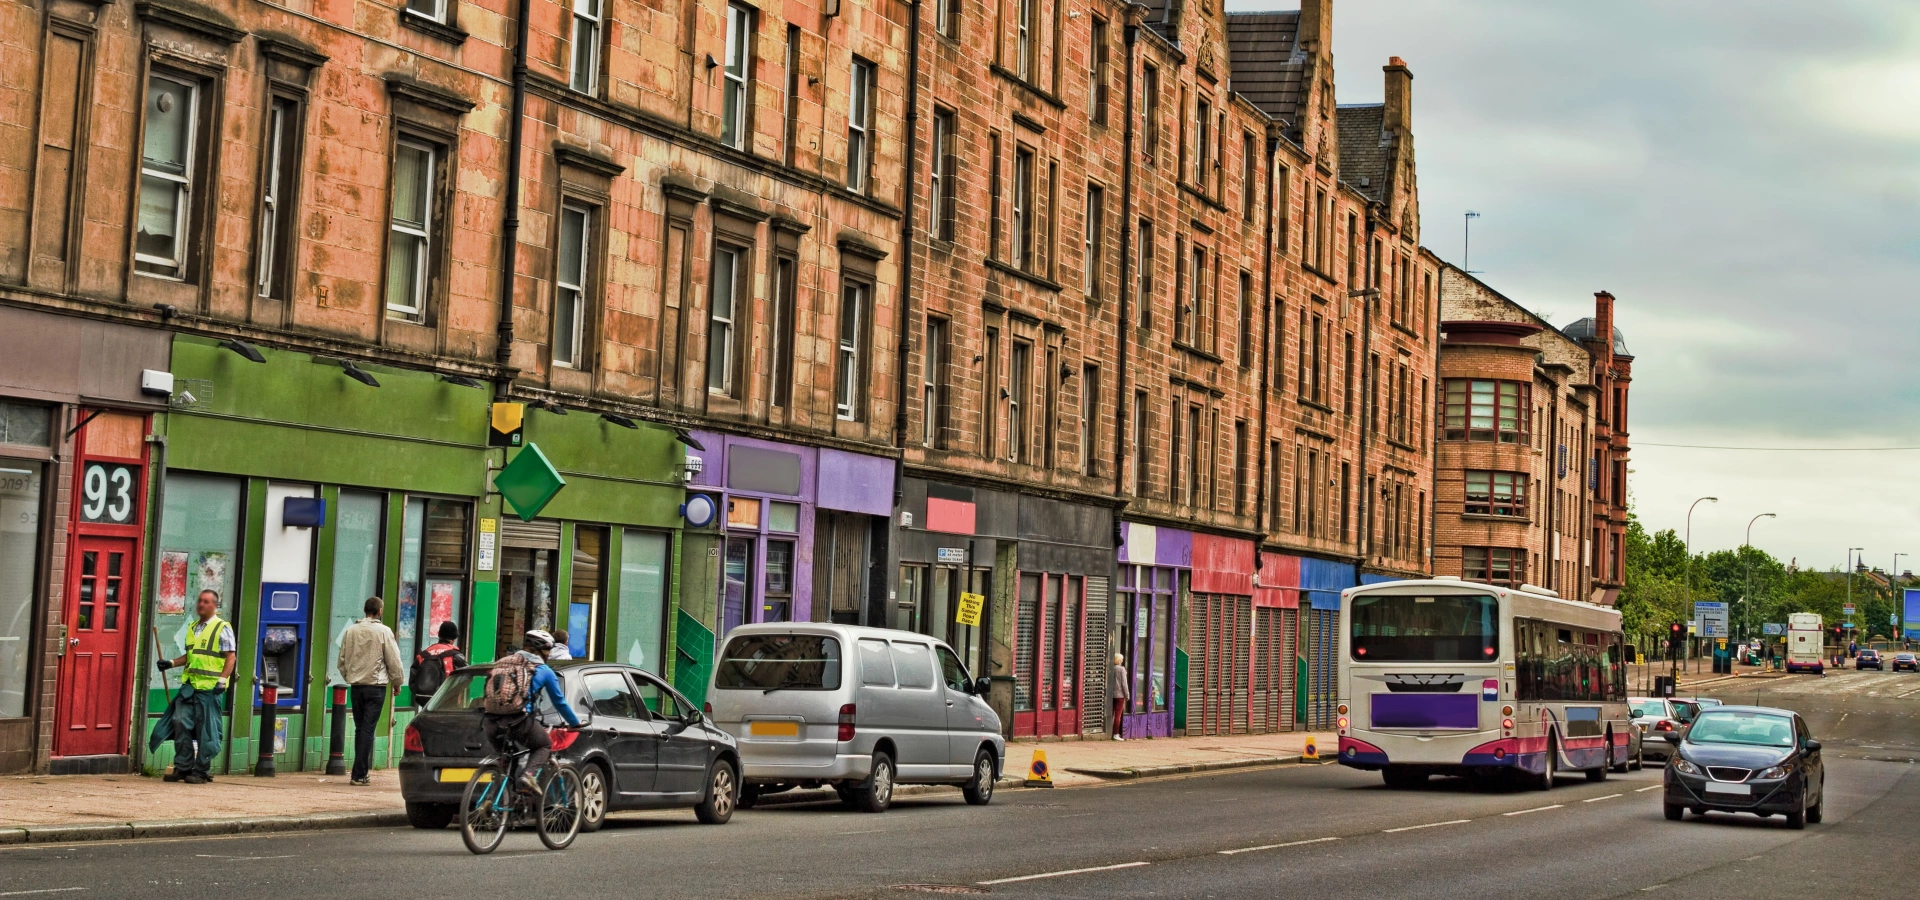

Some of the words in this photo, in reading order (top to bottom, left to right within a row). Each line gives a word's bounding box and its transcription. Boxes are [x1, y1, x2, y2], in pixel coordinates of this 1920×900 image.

[84, 465, 131, 521] 93
[709, 548, 718, 556] 101
[963, 598, 980, 606] Parking
